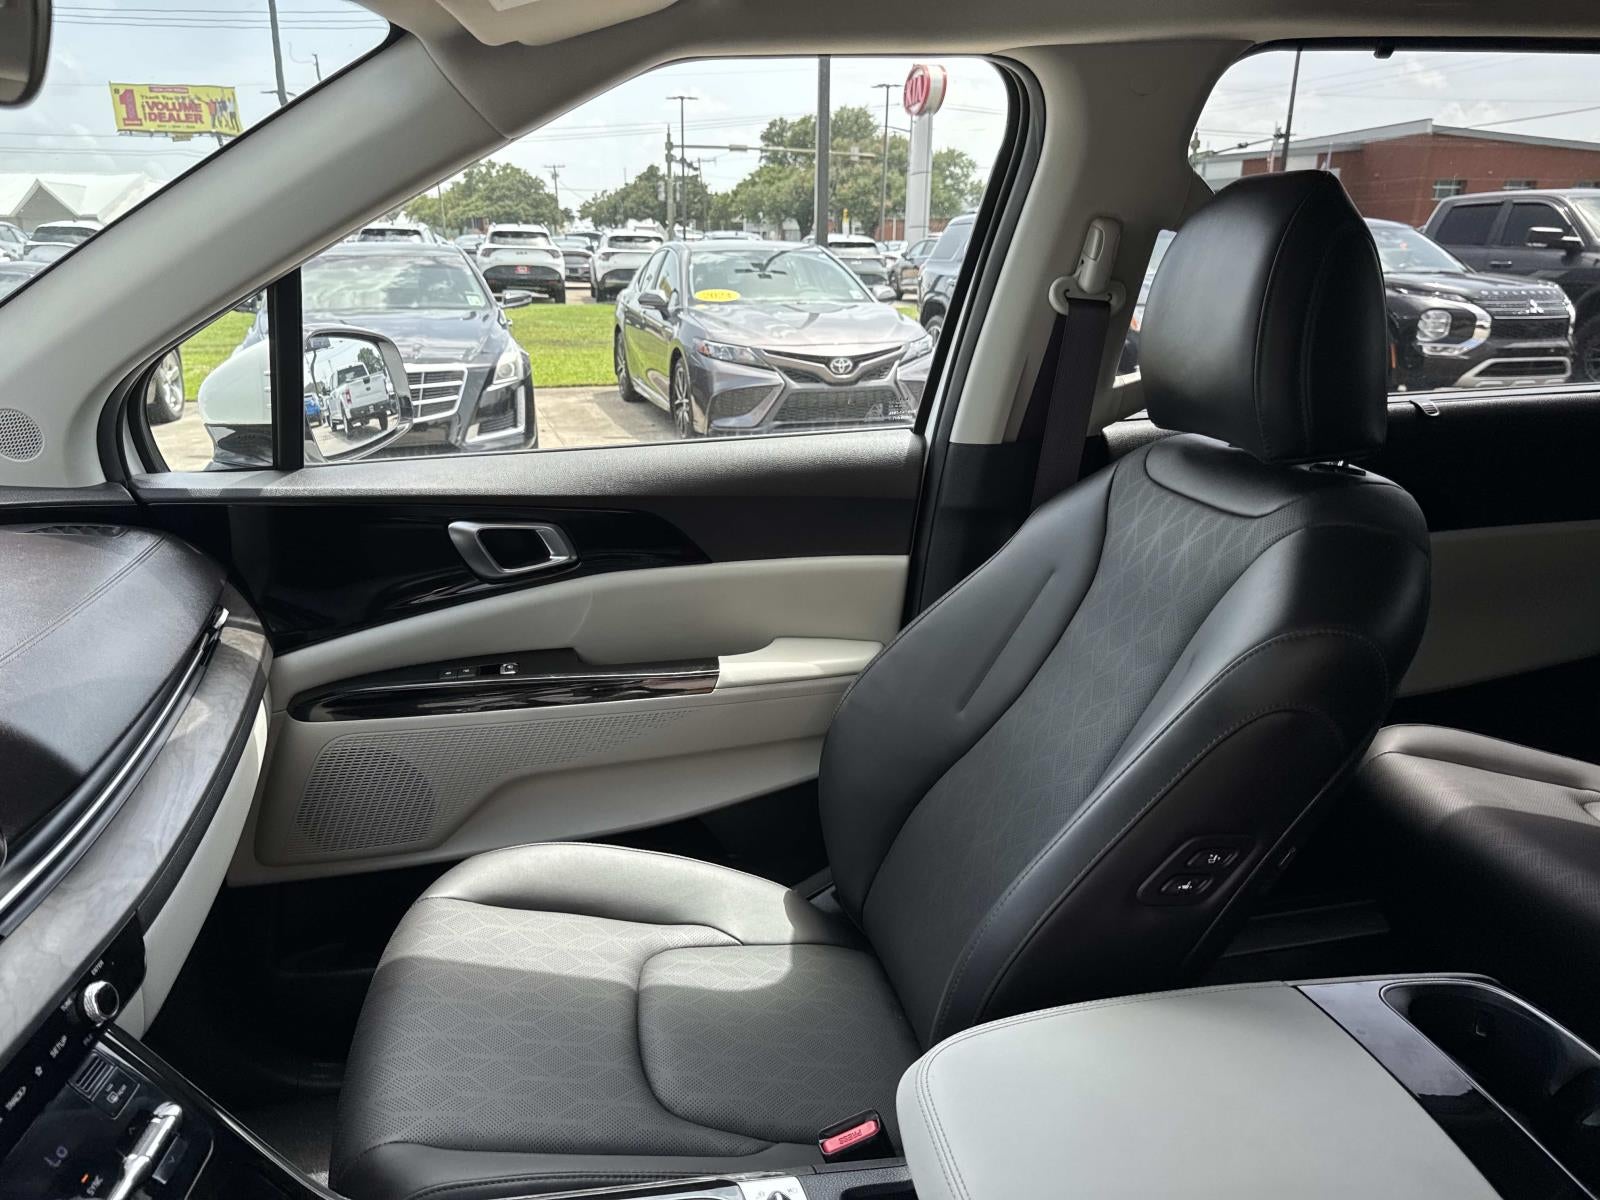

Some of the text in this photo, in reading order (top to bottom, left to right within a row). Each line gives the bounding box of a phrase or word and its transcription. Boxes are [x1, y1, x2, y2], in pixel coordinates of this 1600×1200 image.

[145, 100, 203, 113] VOLUME
[148, 112, 204, 124] DEALER
[49, 1034, 68, 1059] SETUP
[86, 1175, 104, 1197] SYNC
